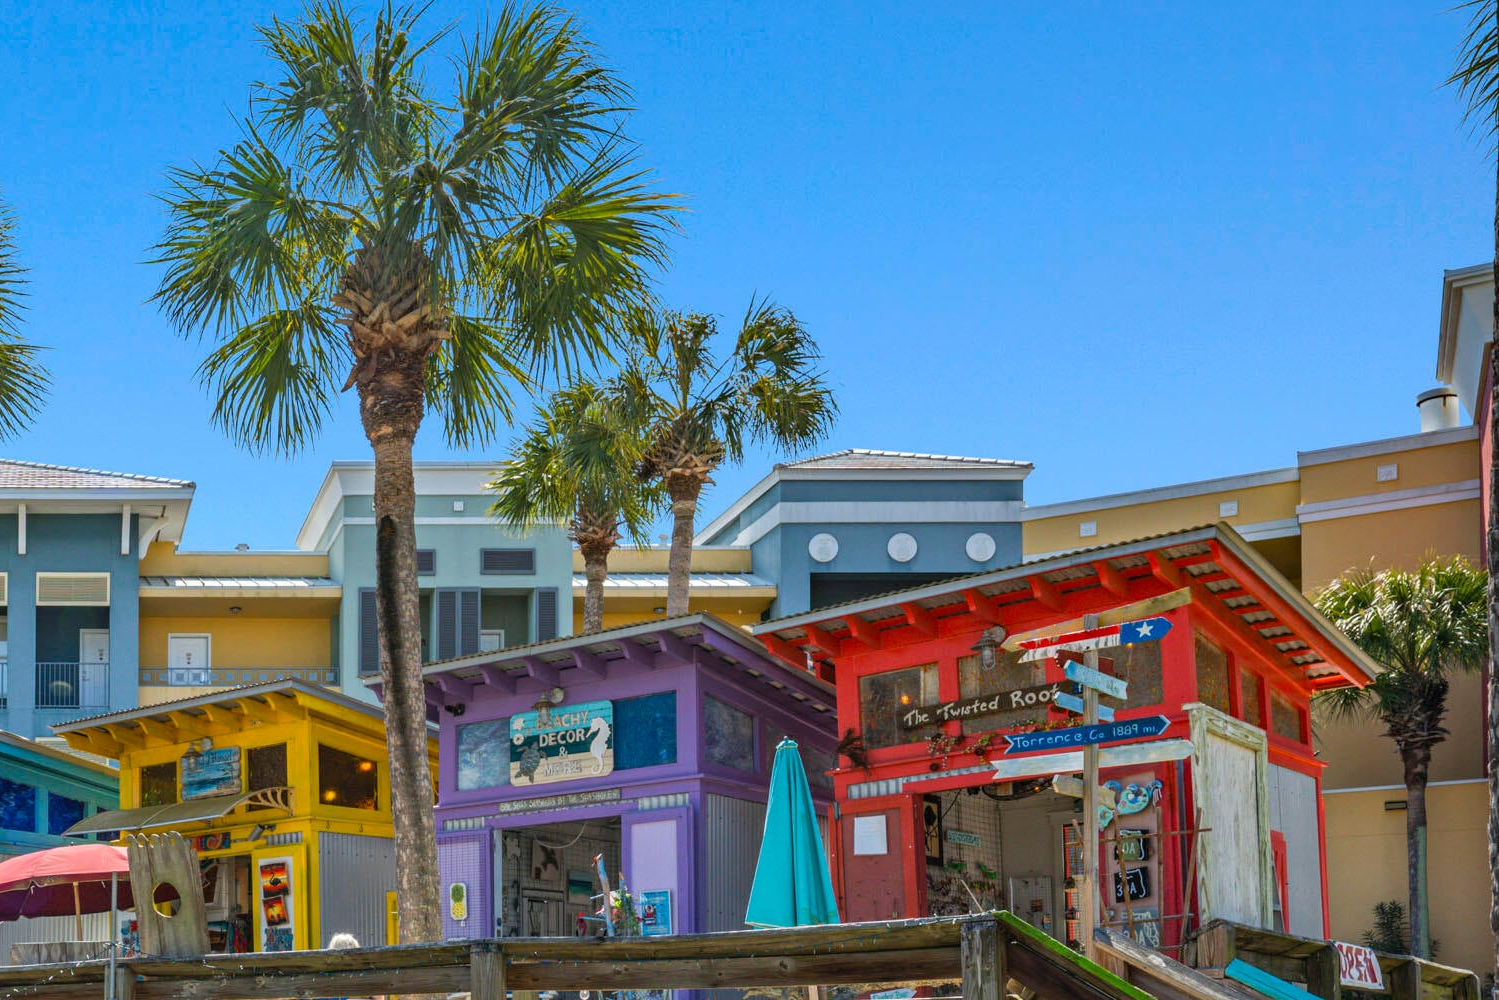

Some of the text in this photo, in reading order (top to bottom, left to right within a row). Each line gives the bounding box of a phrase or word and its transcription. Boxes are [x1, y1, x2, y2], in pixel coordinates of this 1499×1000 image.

[903, 709, 929, 727] The
[937, 694, 999, 721] Twisted
[539, 729, 585, 747] DECOR
[558, 746, 569, 758] &
[1116, 841, 1136, 855] 0A
[1116, 882, 1137, 897] 3A
[1337, 943, 1377, 983] OPEN
